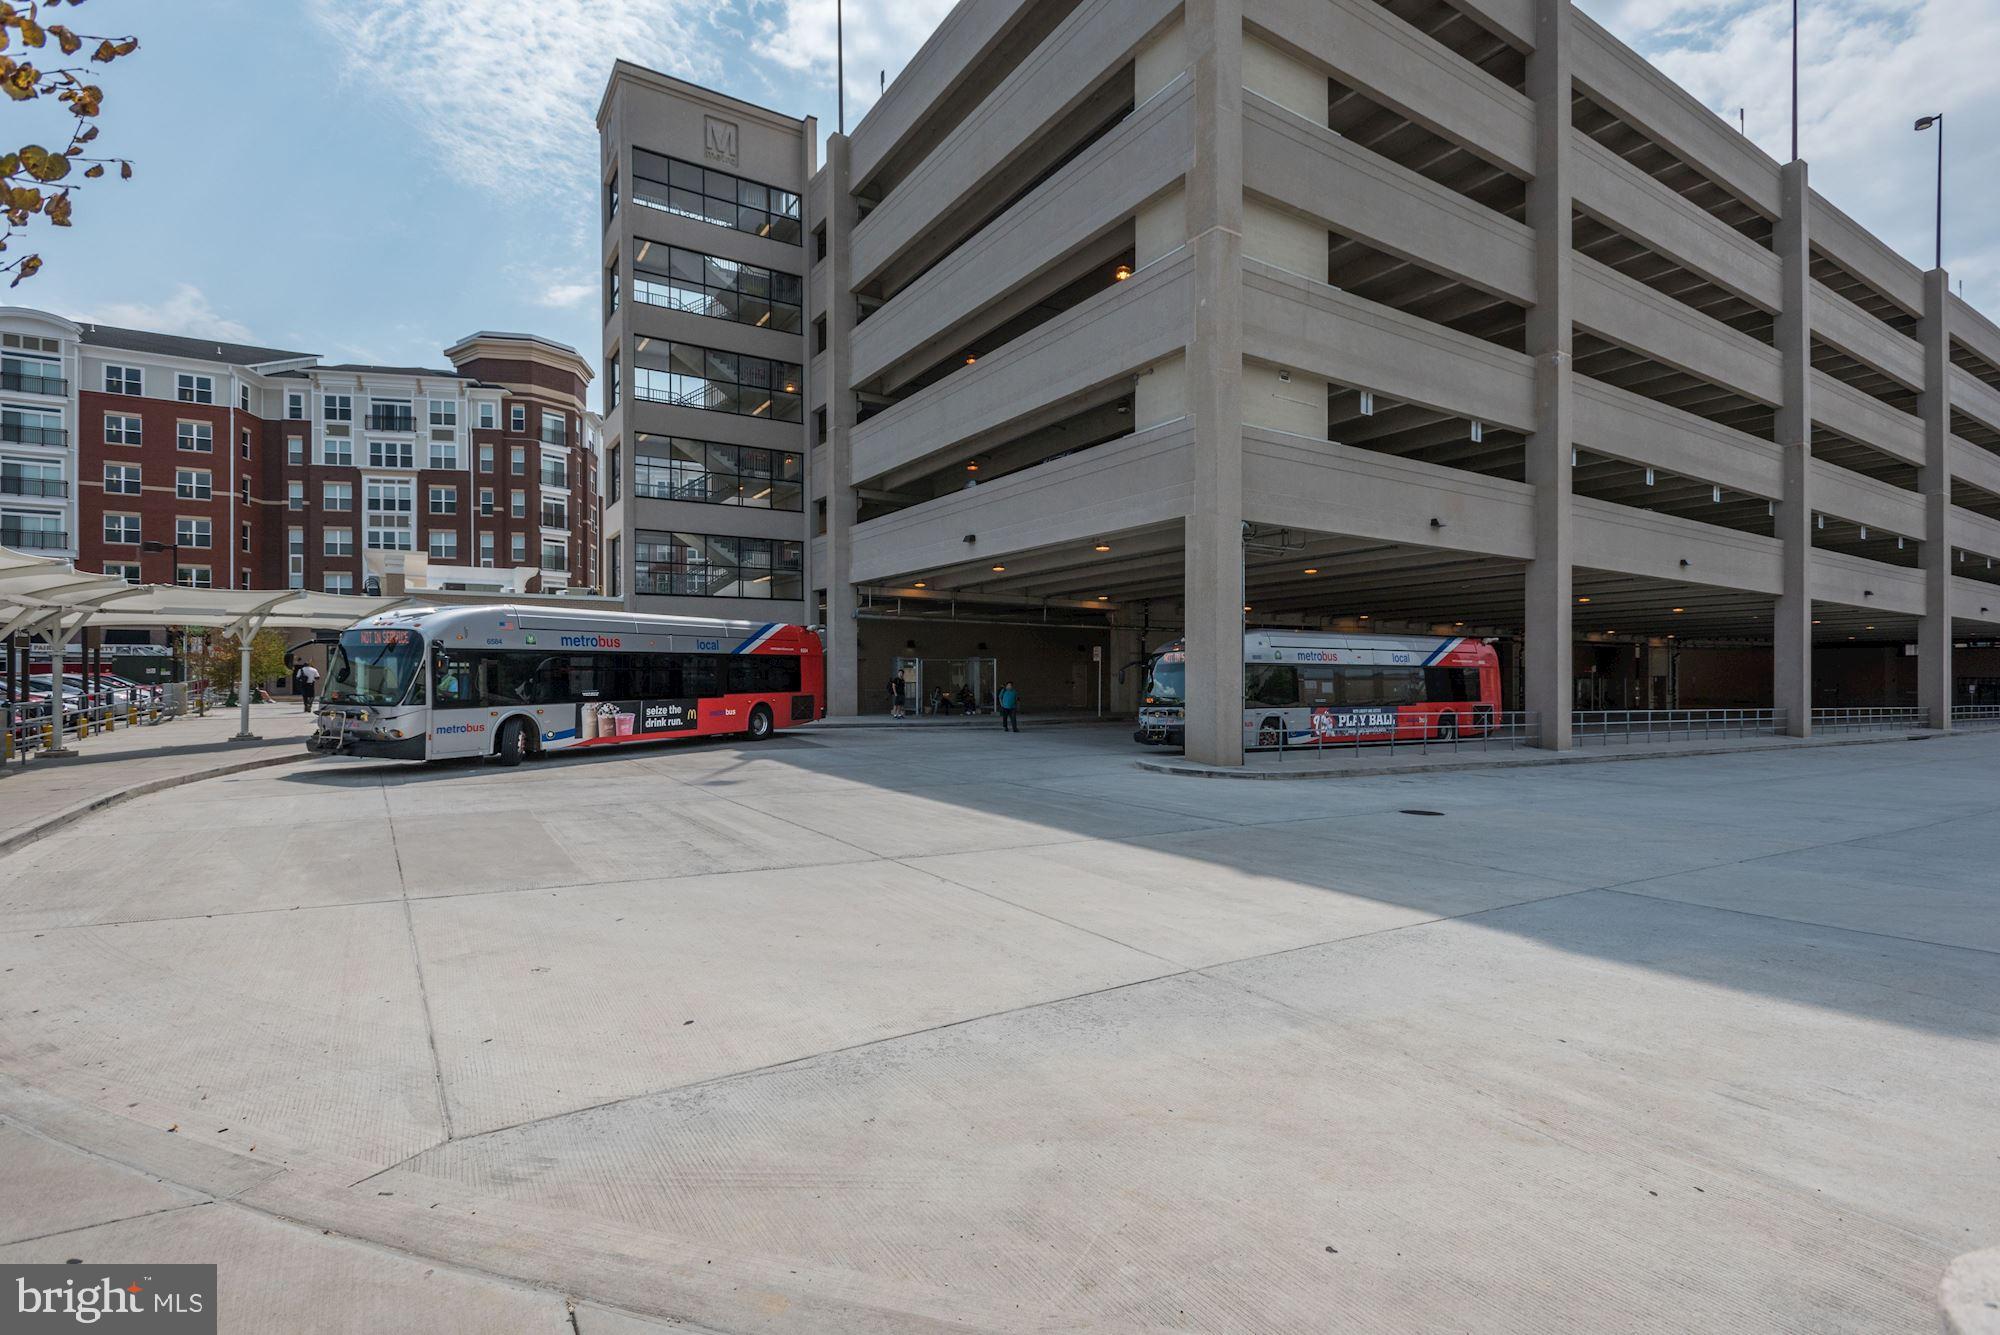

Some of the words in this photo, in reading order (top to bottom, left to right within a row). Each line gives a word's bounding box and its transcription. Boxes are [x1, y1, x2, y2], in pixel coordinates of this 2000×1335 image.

[706, 119, 736, 156] M
[360, 631, 372, 644] NOT
[374, 631, 382, 644] IN
[383, 631, 409, 644] SERVICE
[560, 635, 620, 648] metrobus
[697, 639, 719, 651] local
[1297, 650, 1338, 662] metrobus
[1391, 653, 1411, 664] local
[646, 706, 668, 717] seize
[668, 705, 682, 715] the
[645, 718, 667, 728] drink
[667, 718, 683, 727] run.
[1338, 714, 1367, 727] PLAY
[436, 723, 485, 735] metrobus
